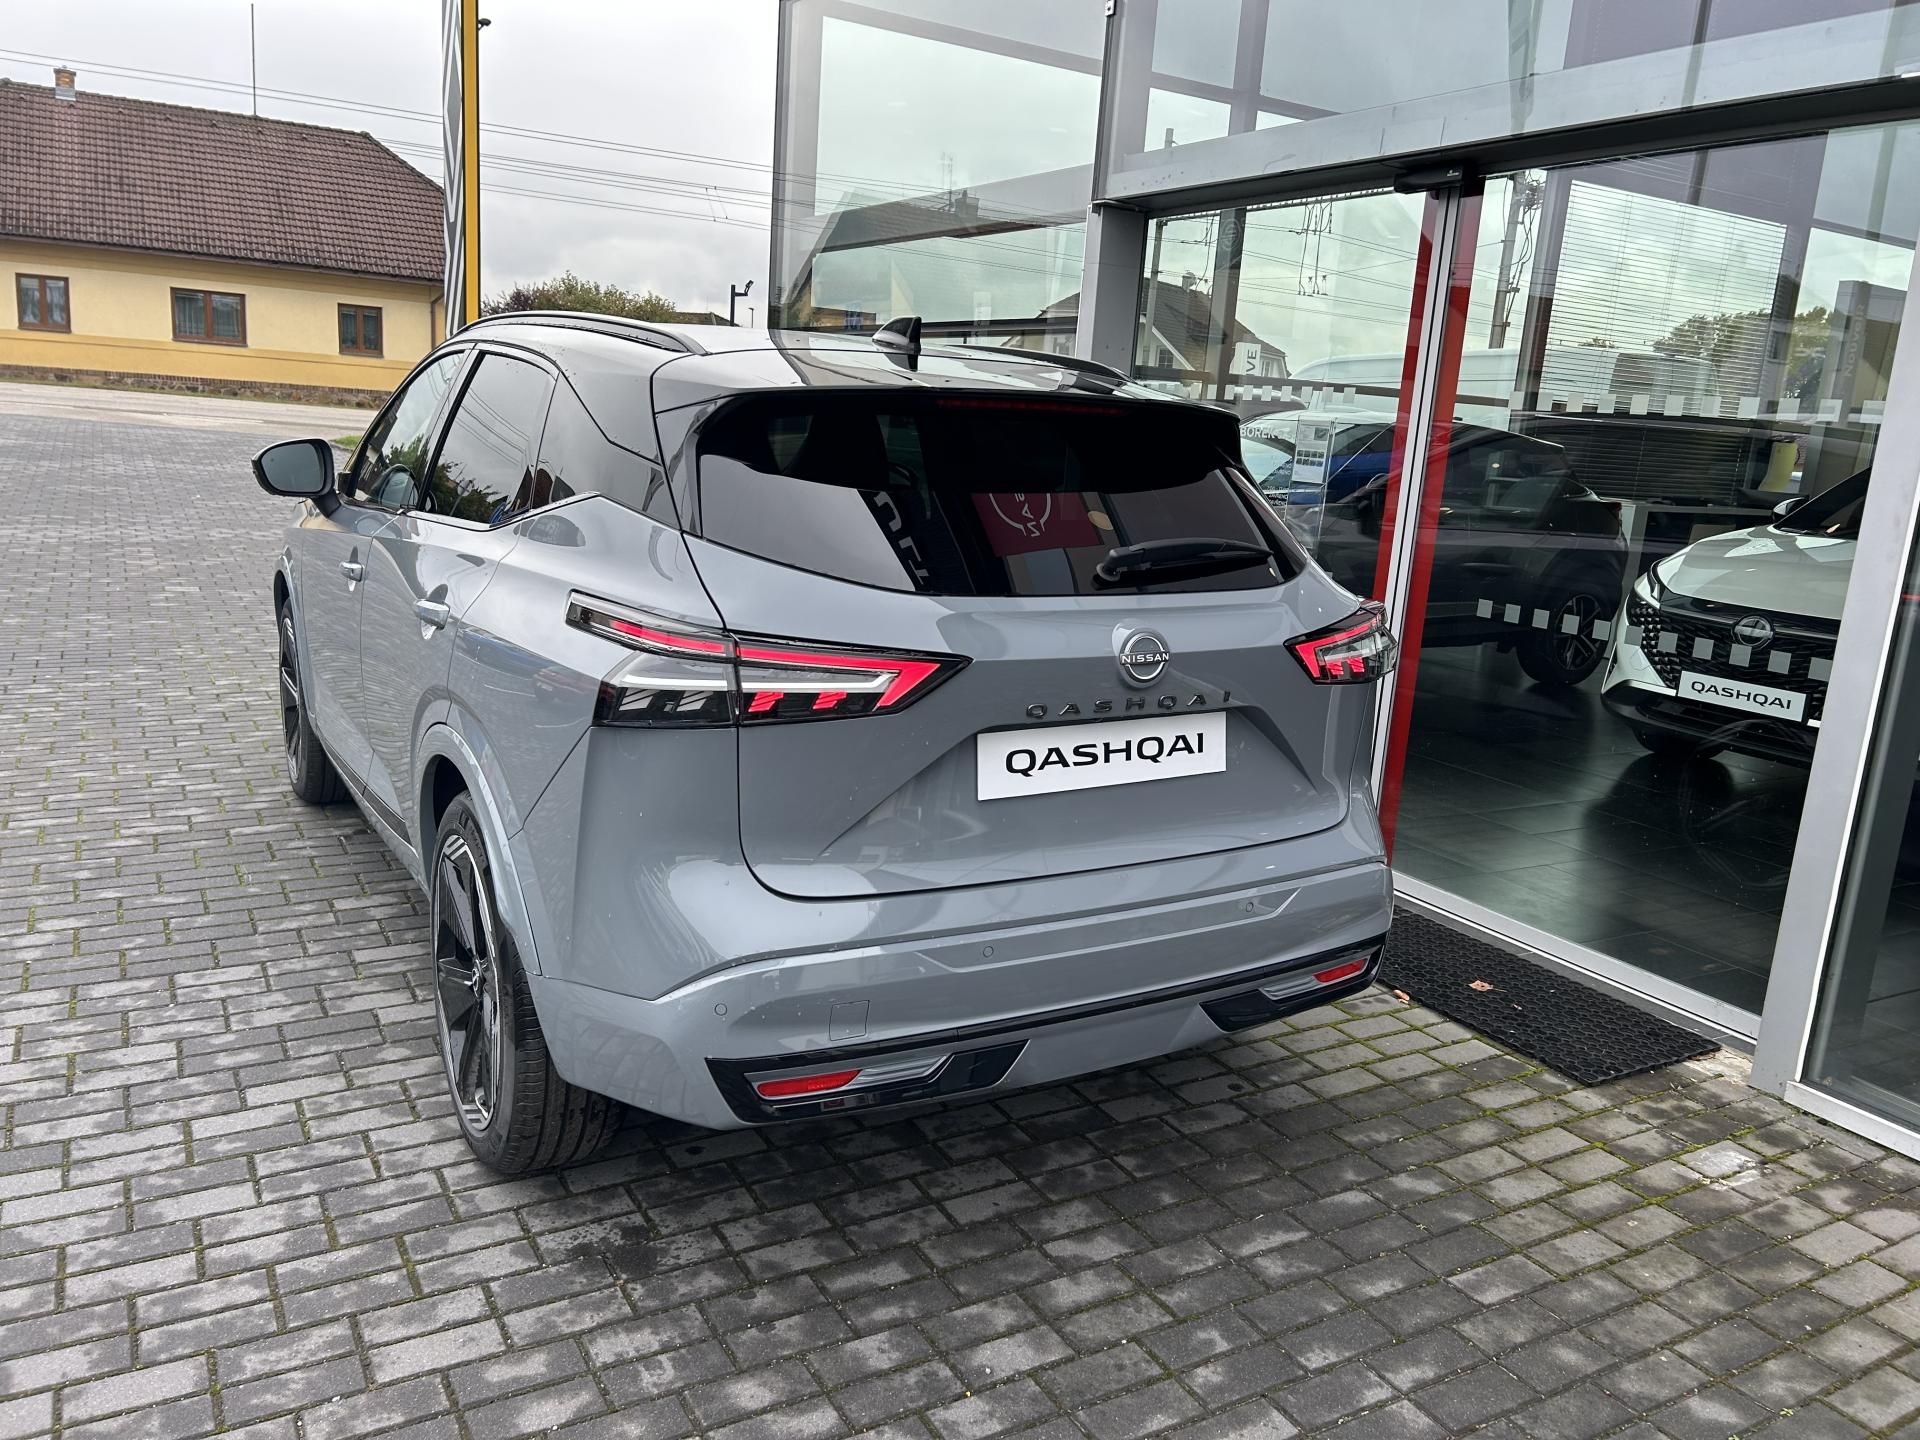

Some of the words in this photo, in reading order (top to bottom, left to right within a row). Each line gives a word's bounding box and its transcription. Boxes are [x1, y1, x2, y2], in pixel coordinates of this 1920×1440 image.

[1121, 652, 1169, 663] NISSAN
[1026, 691, 1231, 719] QASHQAI
[1690, 681, 1792, 709] QASHQAI
[1005, 732, 1204, 777] QASHQAI
